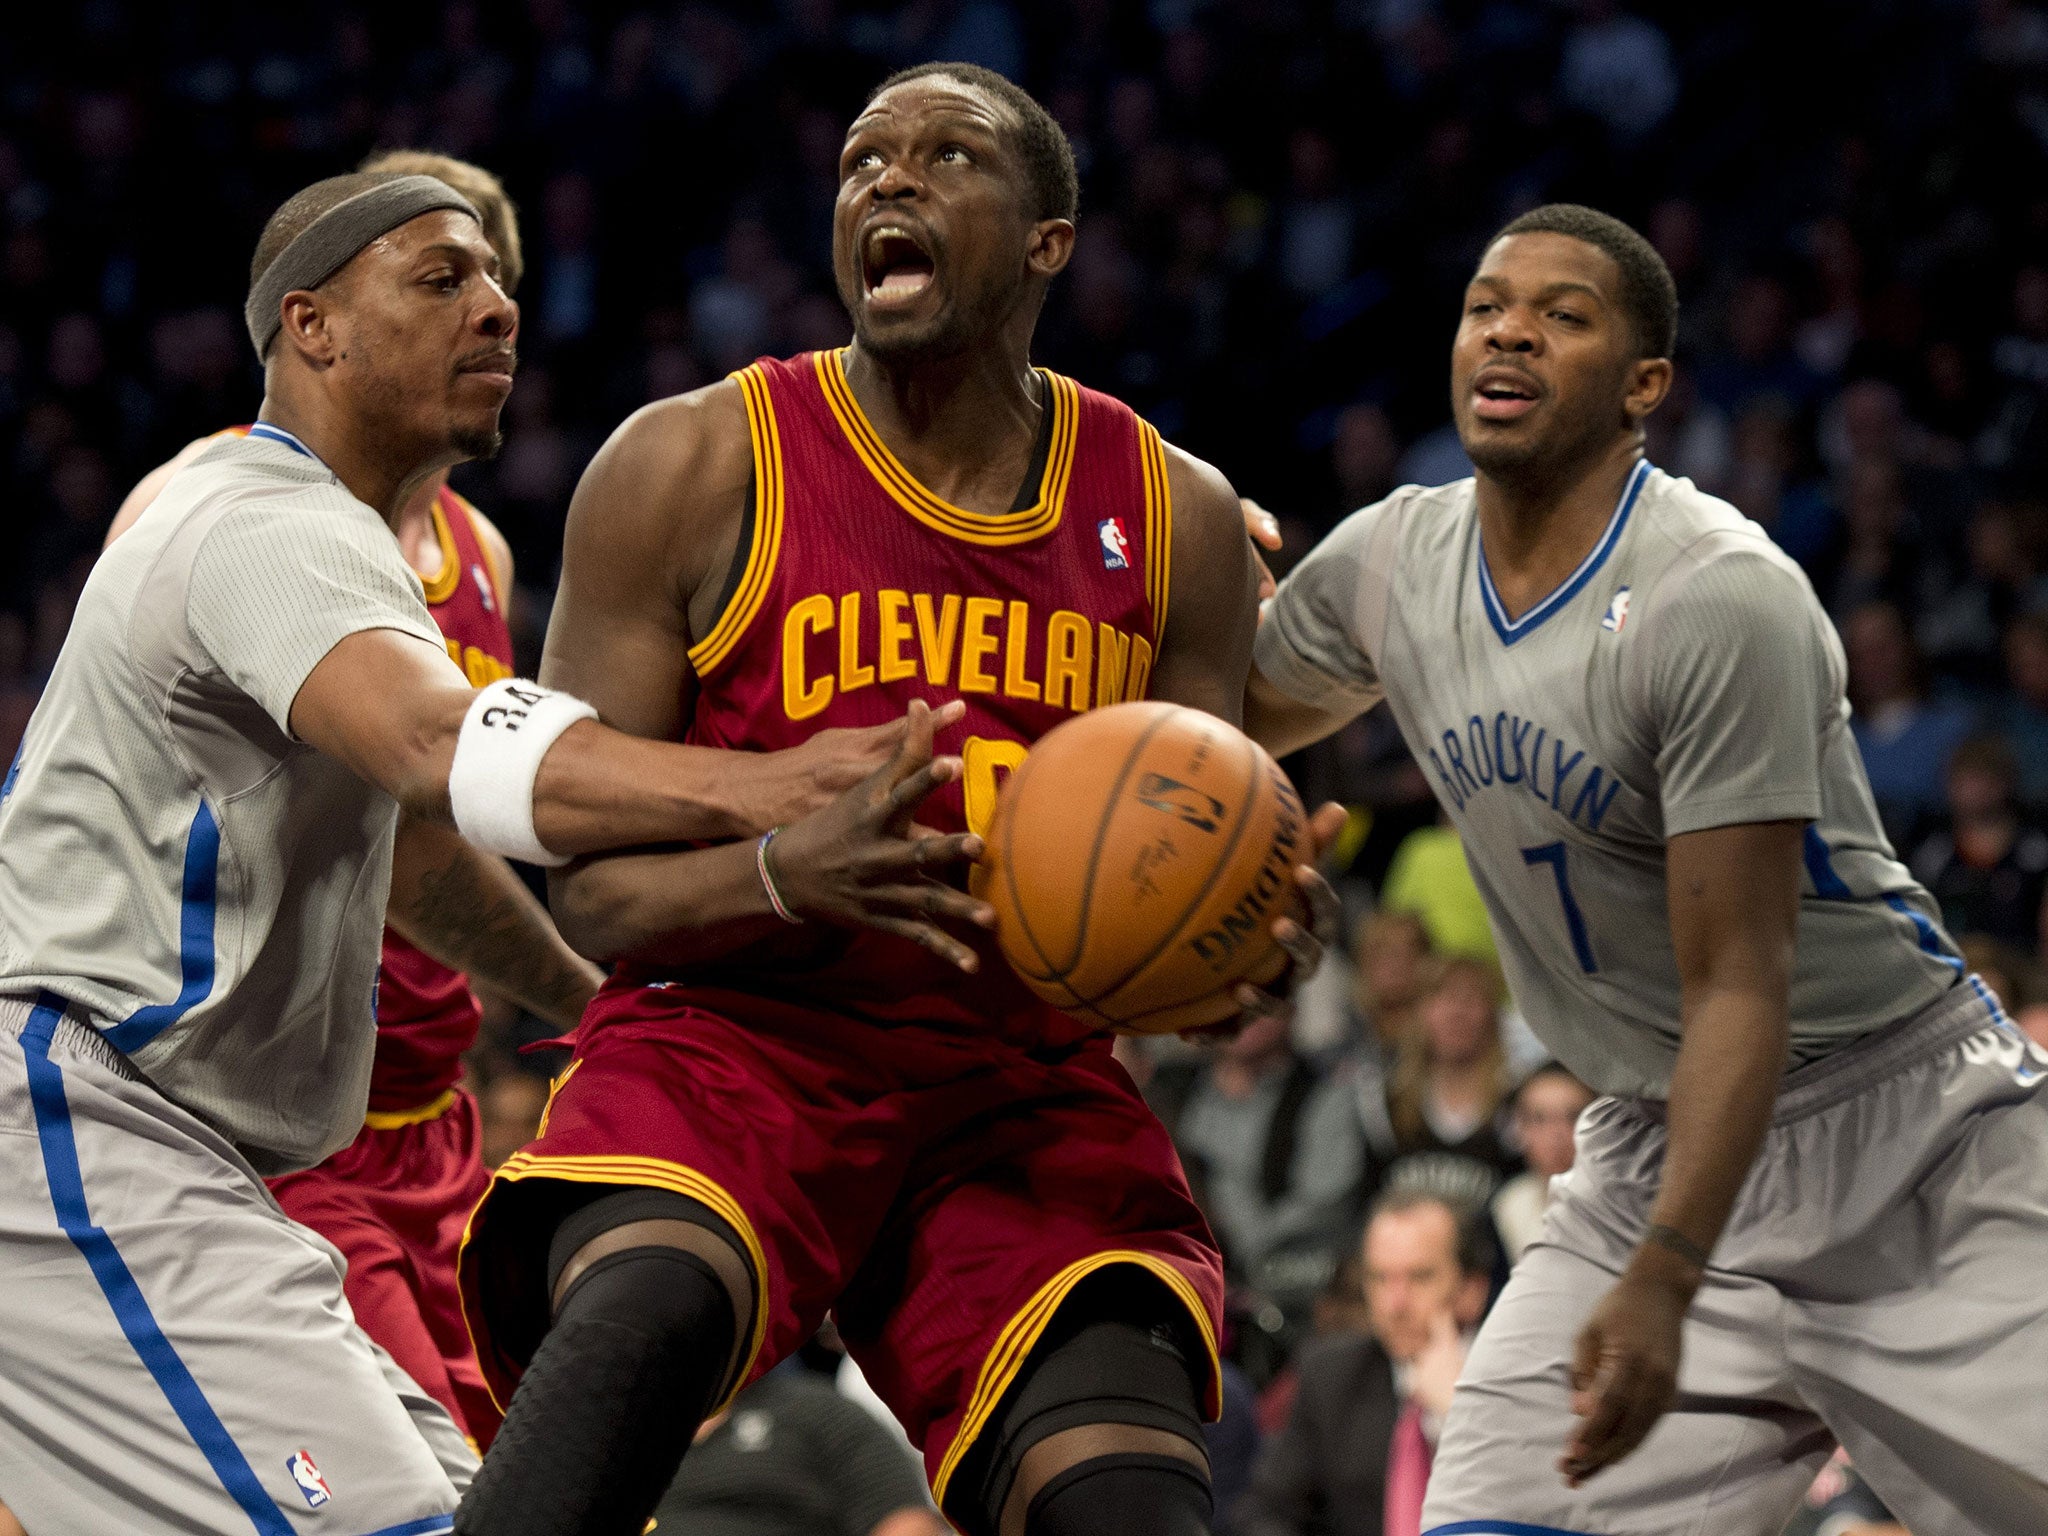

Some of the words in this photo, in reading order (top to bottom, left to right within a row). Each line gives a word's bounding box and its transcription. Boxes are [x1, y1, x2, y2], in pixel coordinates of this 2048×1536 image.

[1105, 557, 1125, 569] NBA
[783, 589, 1152, 721] CLEVELAND
[482, 686, 549, 732] 34
[1521, 841, 1598, 974] 7
